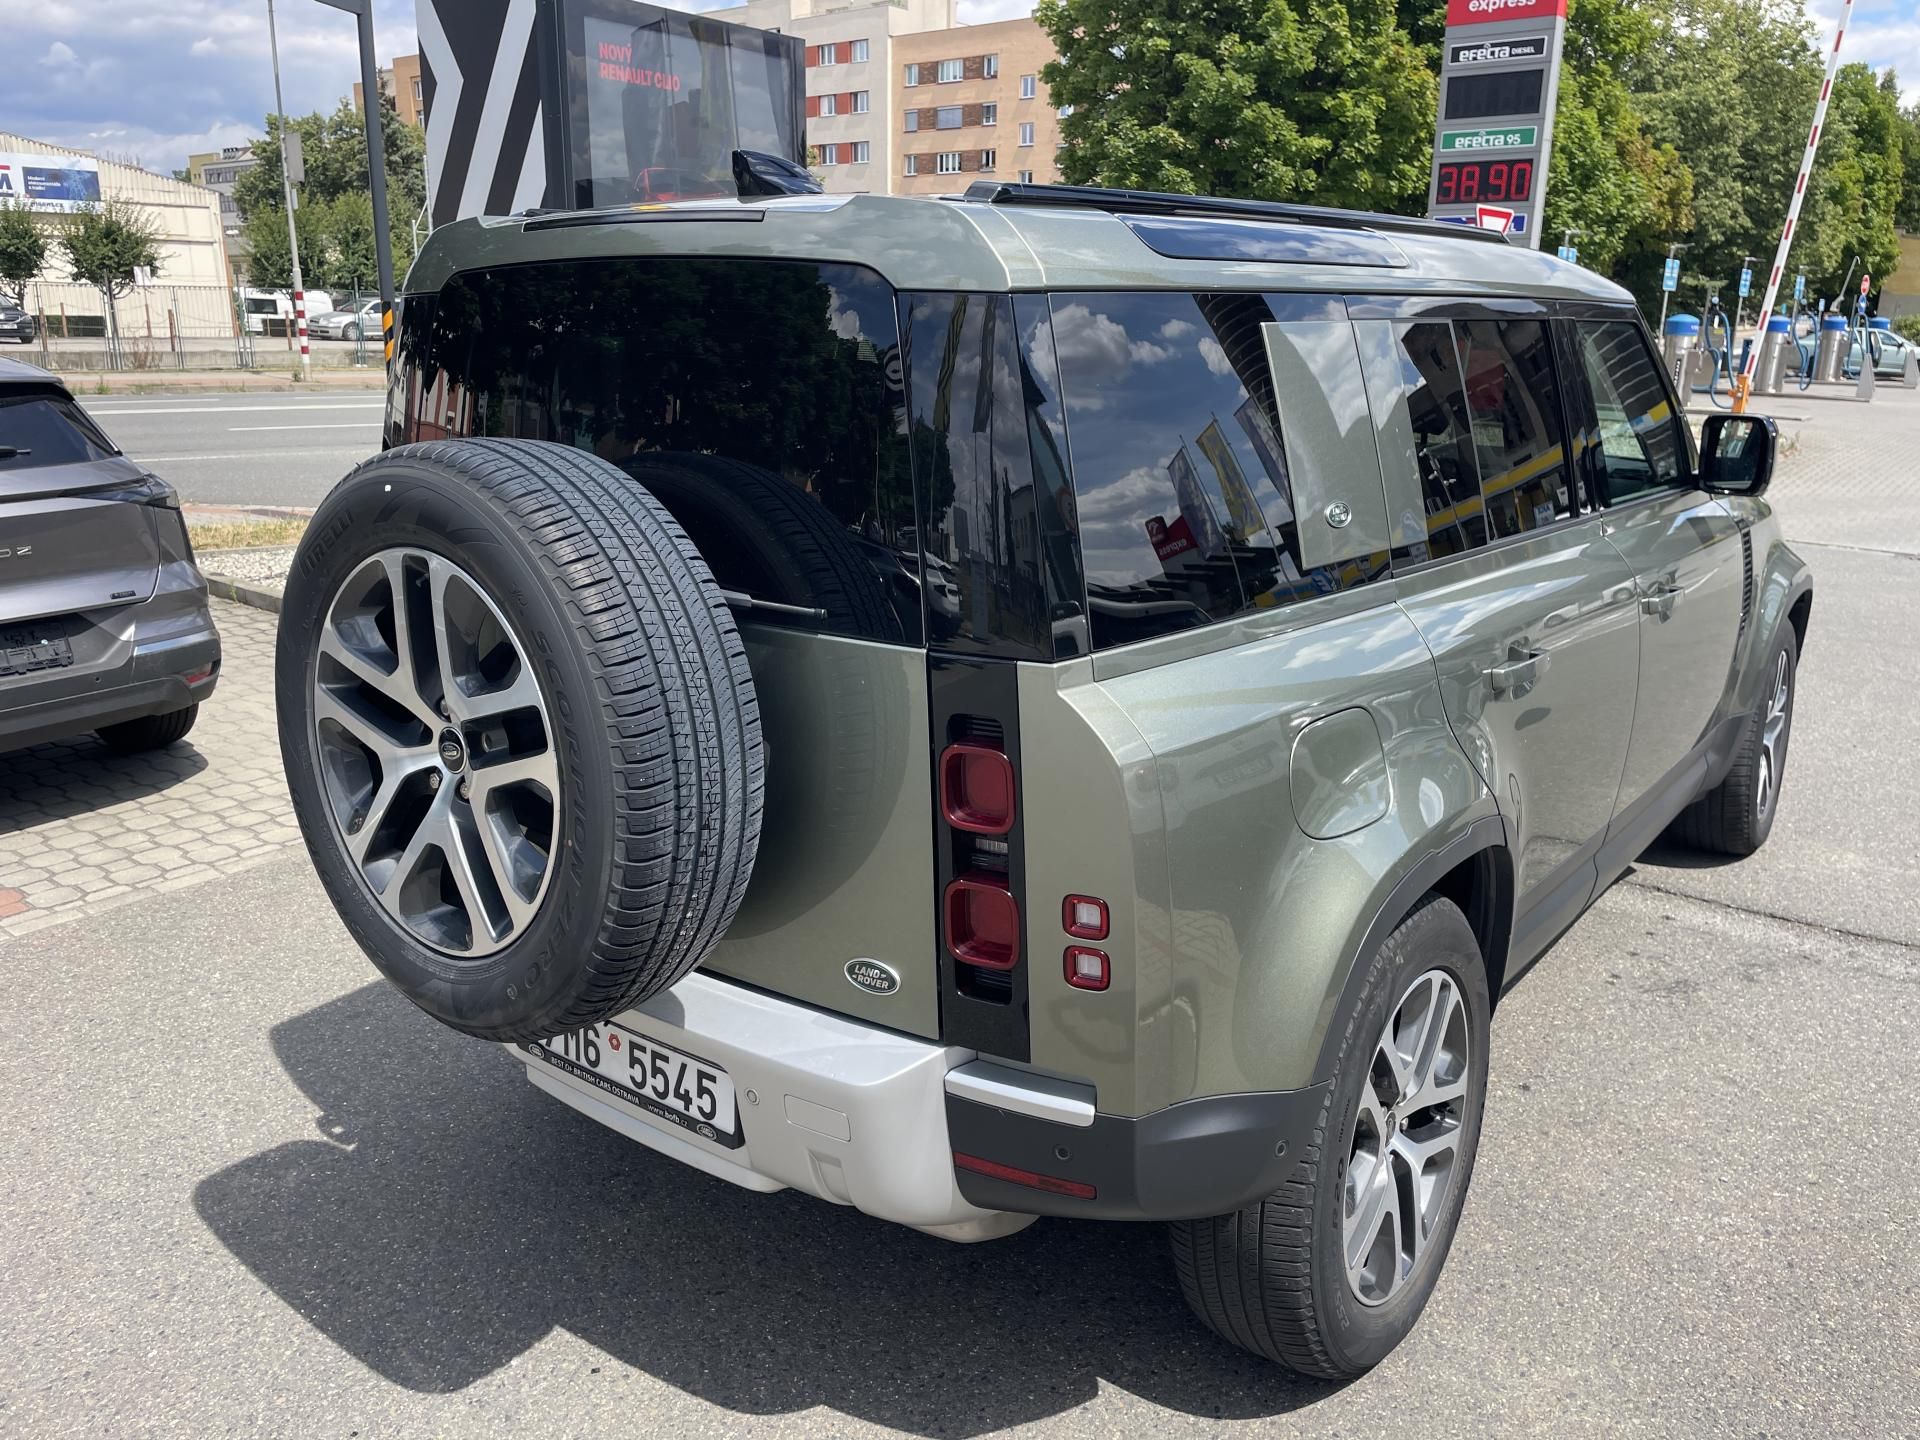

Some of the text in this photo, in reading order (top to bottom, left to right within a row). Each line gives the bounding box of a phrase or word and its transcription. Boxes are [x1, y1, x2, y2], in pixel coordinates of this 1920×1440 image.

[599, 41, 632, 64] NOVÝ
[1511, 46, 1535, 55] DIESEL
[599, 62, 680, 92] RENAULT CLIO
[1506, 134, 1521, 145] 95
[1438, 162, 1532, 203] 38.90
[854, 964, 880, 979] LAND
[857, 974, 889, 990] ROVER
[545, 1022, 717, 1121] M6 5545
[551, 1057, 564, 1068] BEST
[565, 1063, 573, 1072] OF
[573, 1067, 596, 1083] BRITISH
[596, 1078, 611, 1091] CARS
[611, 1085, 640, 1105] OSTRAVA
